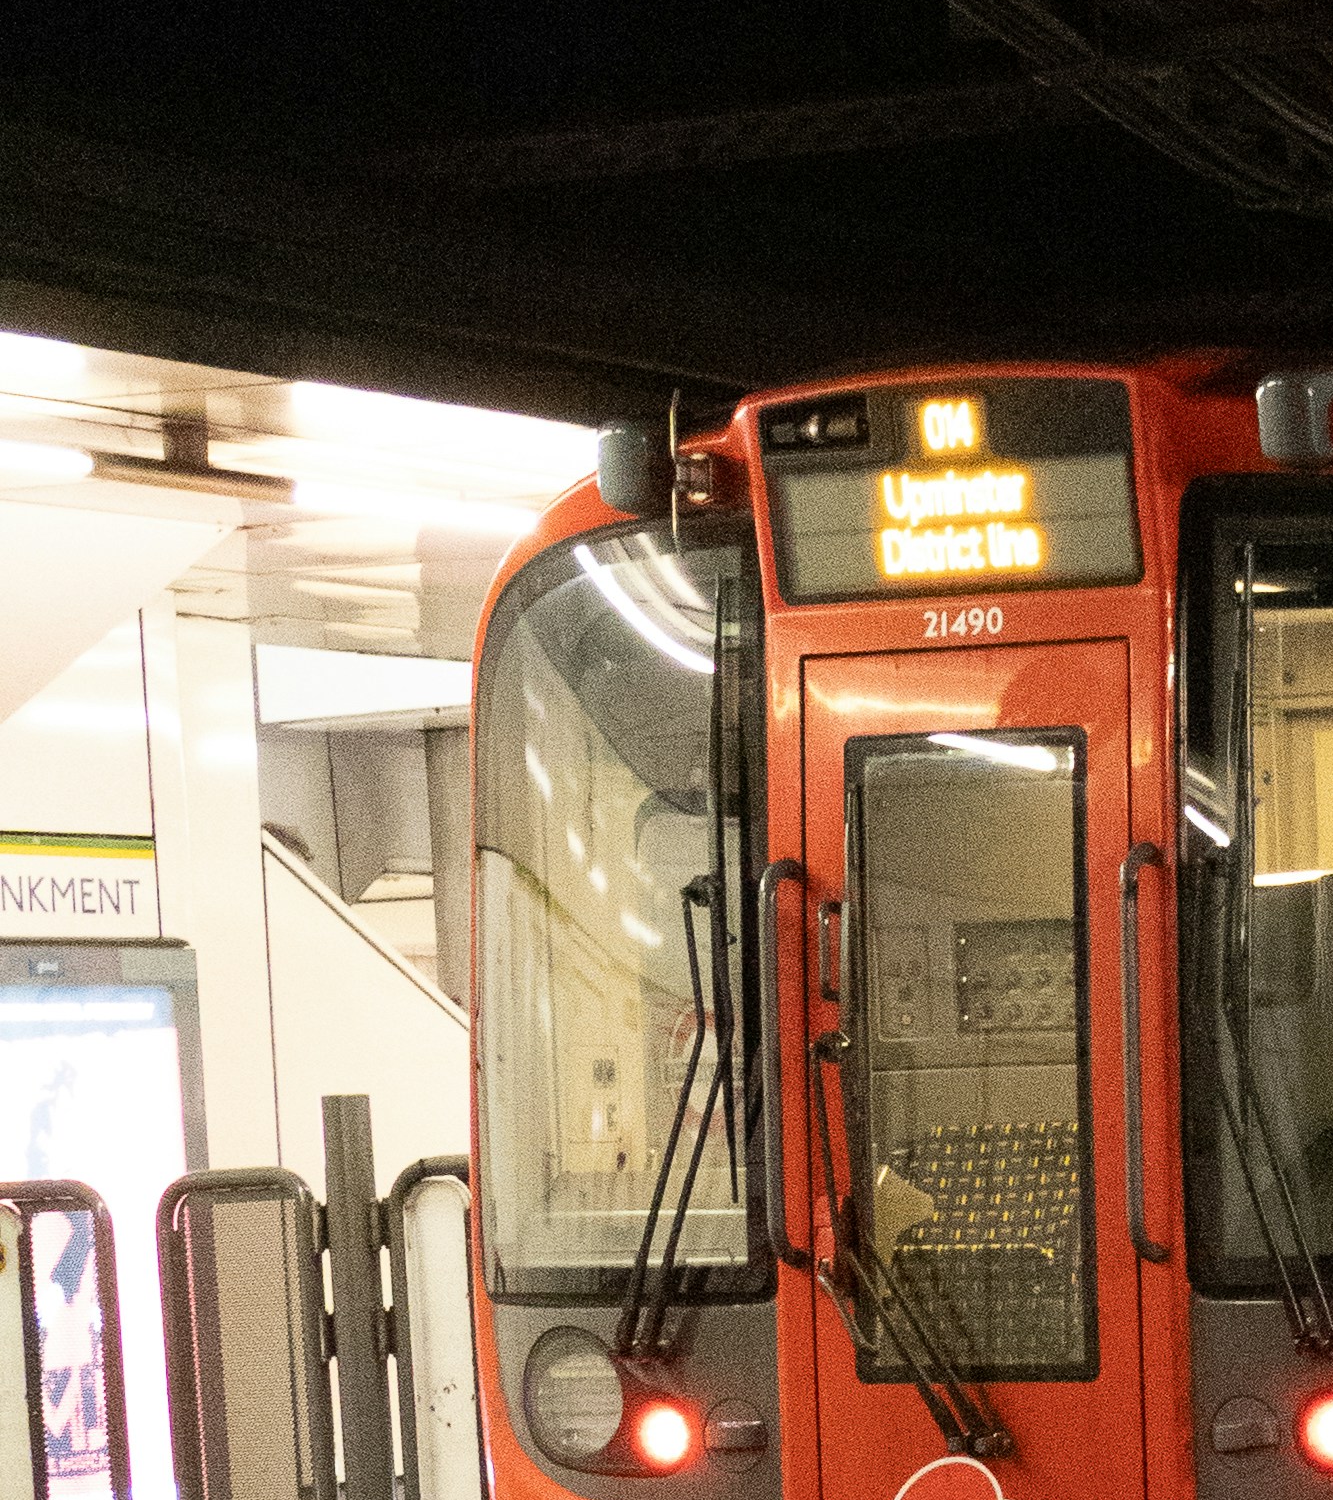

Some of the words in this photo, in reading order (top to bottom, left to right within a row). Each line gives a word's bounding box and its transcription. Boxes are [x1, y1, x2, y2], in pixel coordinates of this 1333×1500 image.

[924, 401, 974, 450] 014
[883, 470, 1025, 526] Upminster
[881, 525, 985, 575] District
[986, 522, 1040, 568] line
[923, 606, 1004, 638] 21490
[0, 875, 140, 915] NKMENT
